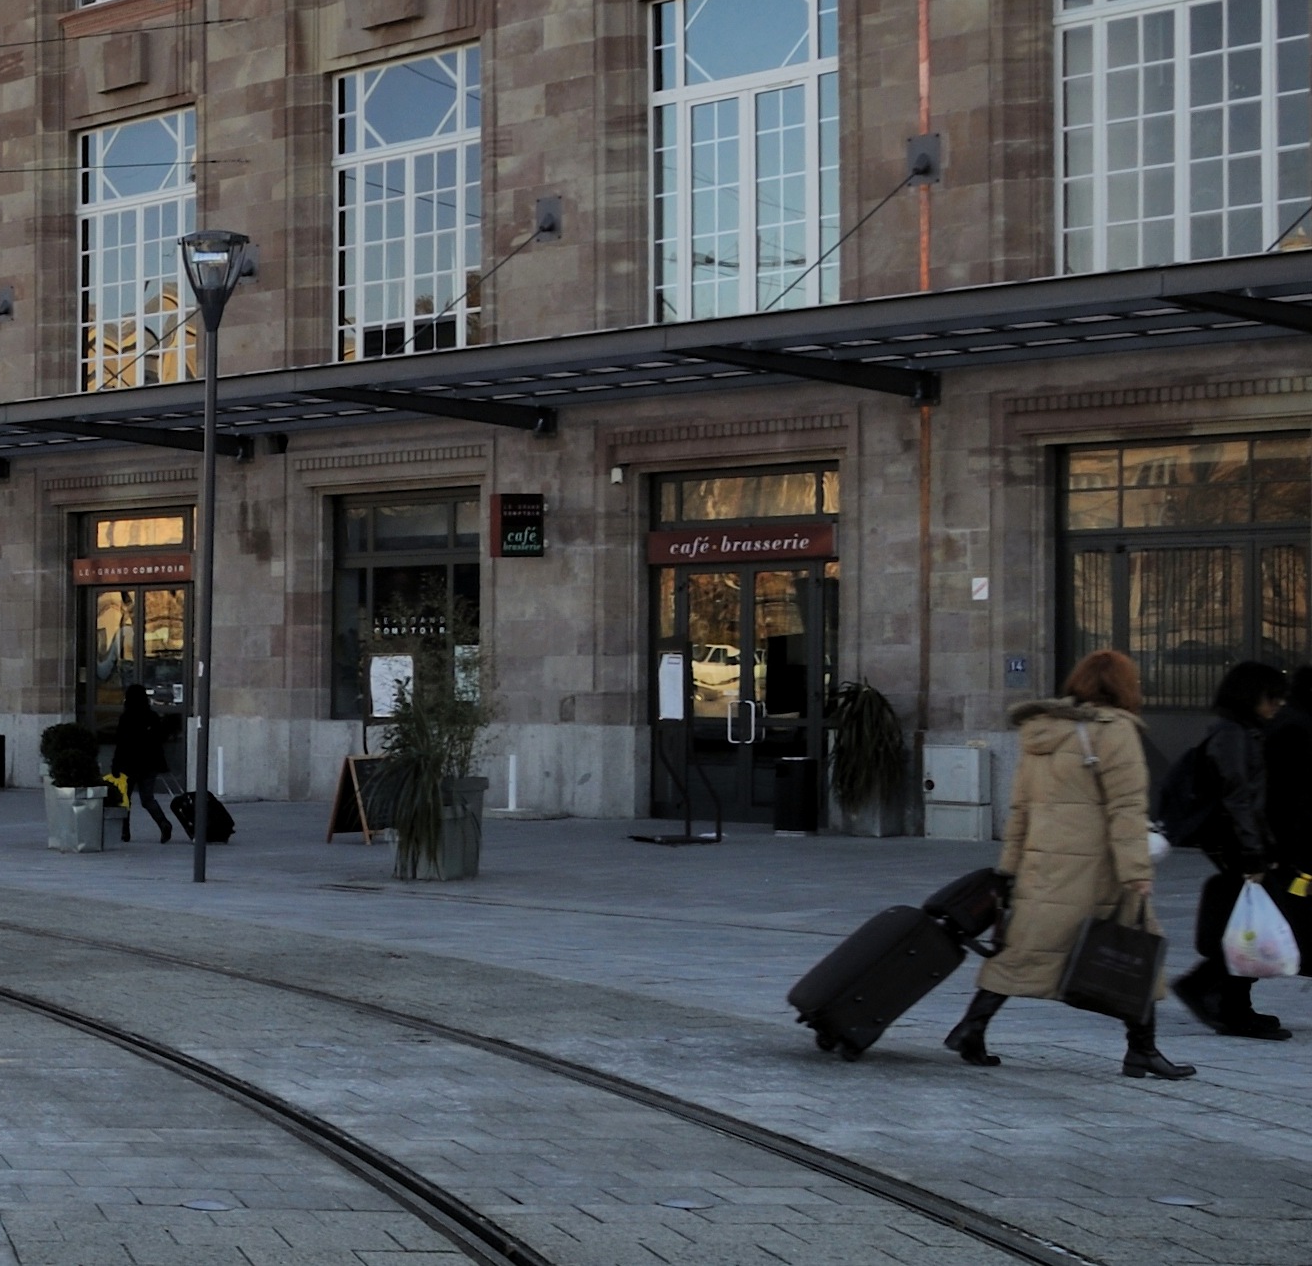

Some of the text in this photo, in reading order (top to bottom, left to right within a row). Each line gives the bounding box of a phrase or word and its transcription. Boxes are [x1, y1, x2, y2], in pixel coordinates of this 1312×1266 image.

[507, 526, 537, 546] café
[503, 540, 541, 551] brasserie
[669, 533, 810, 558] café brasserie
[97, 567, 129, 576] GRAND
[132, 564, 185, 574] COMPTOIR
[373, 626, 446, 635] COMPTOIR
[1010, 661, 1024, 671] 14
